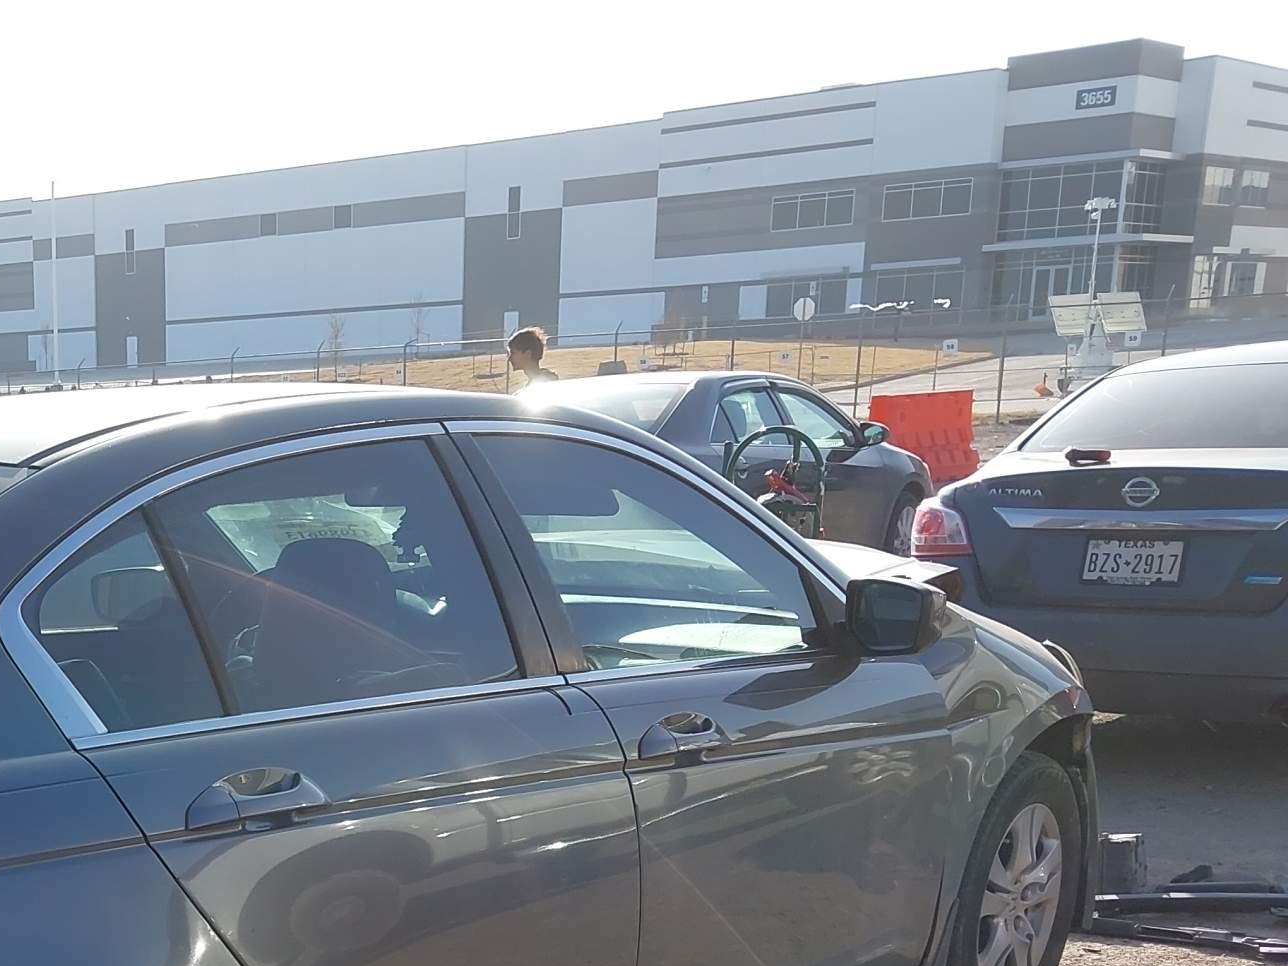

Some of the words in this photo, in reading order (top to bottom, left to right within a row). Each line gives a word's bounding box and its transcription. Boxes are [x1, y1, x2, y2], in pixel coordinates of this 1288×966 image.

[1079, 89, 1112, 106] 3655
[988, 488, 1043, 497] ALTIMA
[1117, 539, 1155, 549] TEXAS
